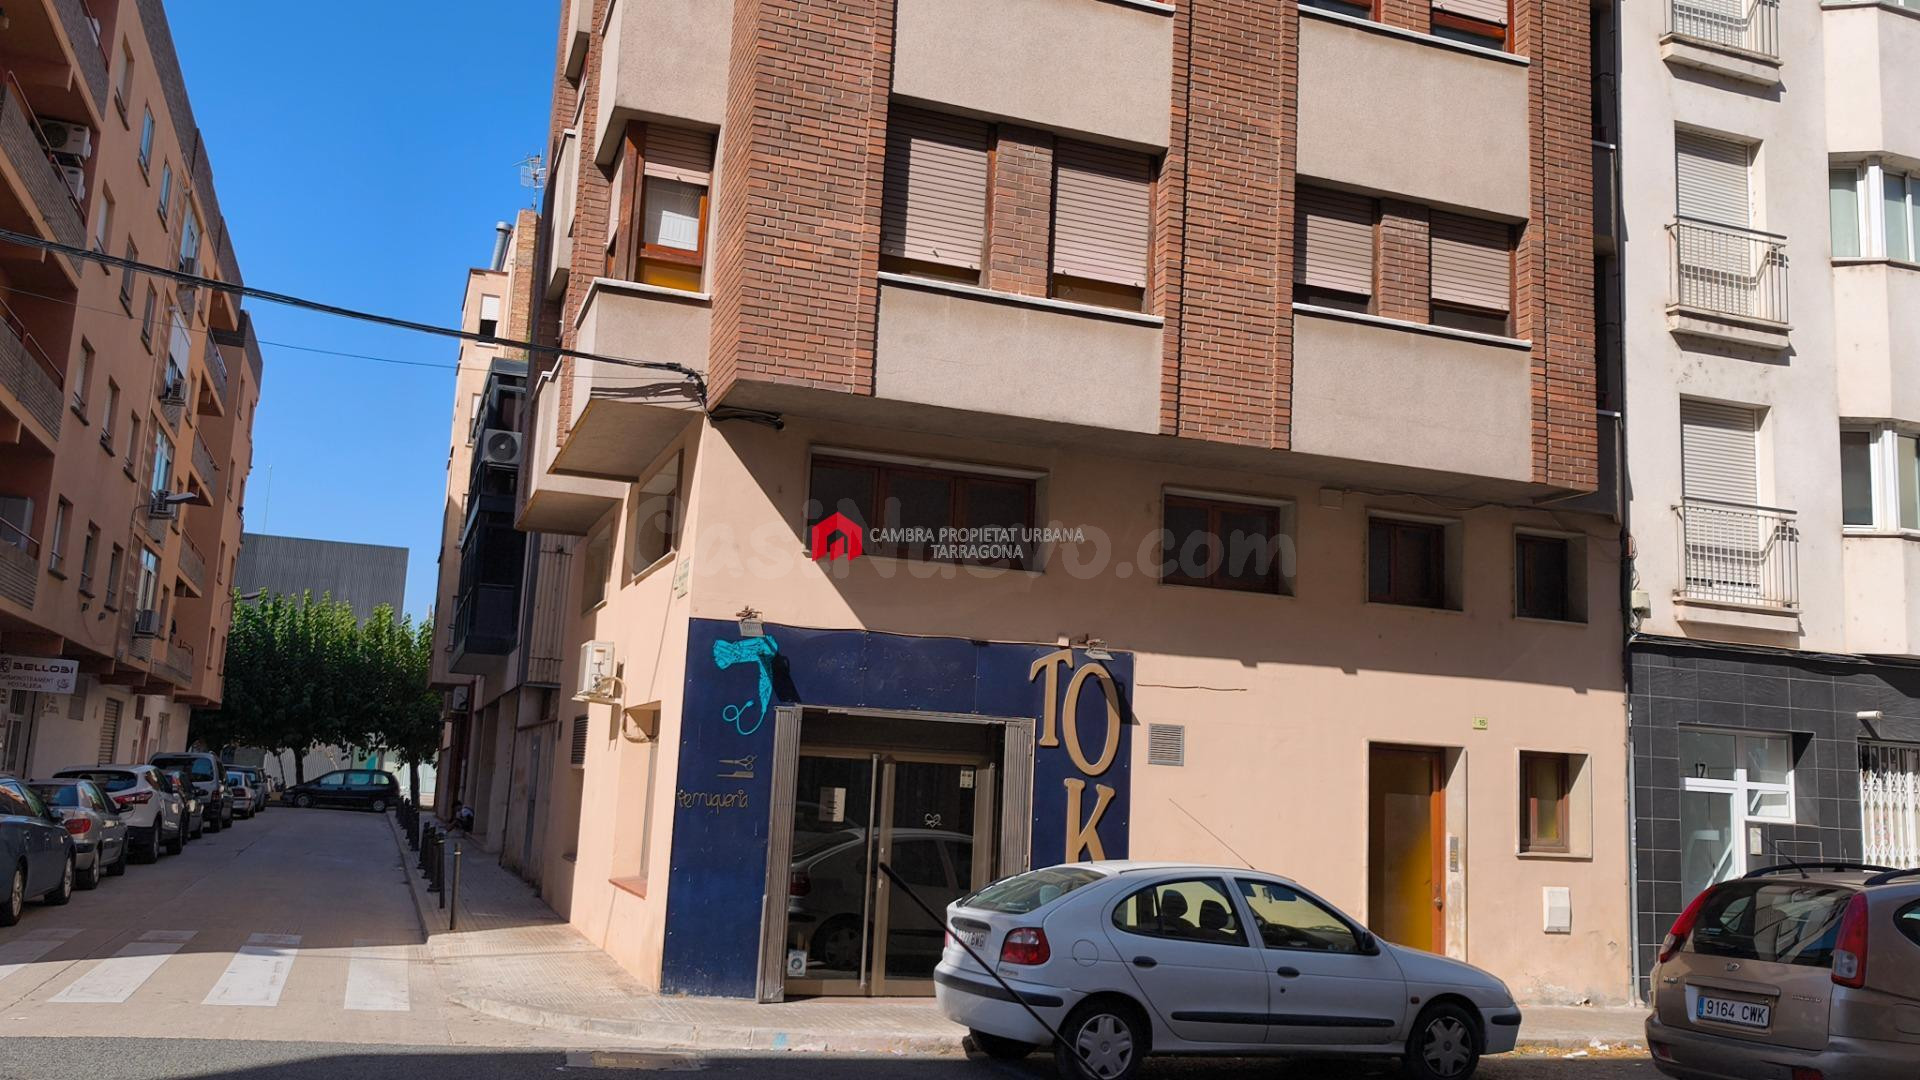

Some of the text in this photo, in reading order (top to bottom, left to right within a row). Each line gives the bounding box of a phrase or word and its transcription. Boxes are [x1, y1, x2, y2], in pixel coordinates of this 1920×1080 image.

[13, 661, 74, 674] BELLOBI
[1695, 763, 1706, 778] 17
[1706, 1000, 1767, 1024] 9164 CWK
